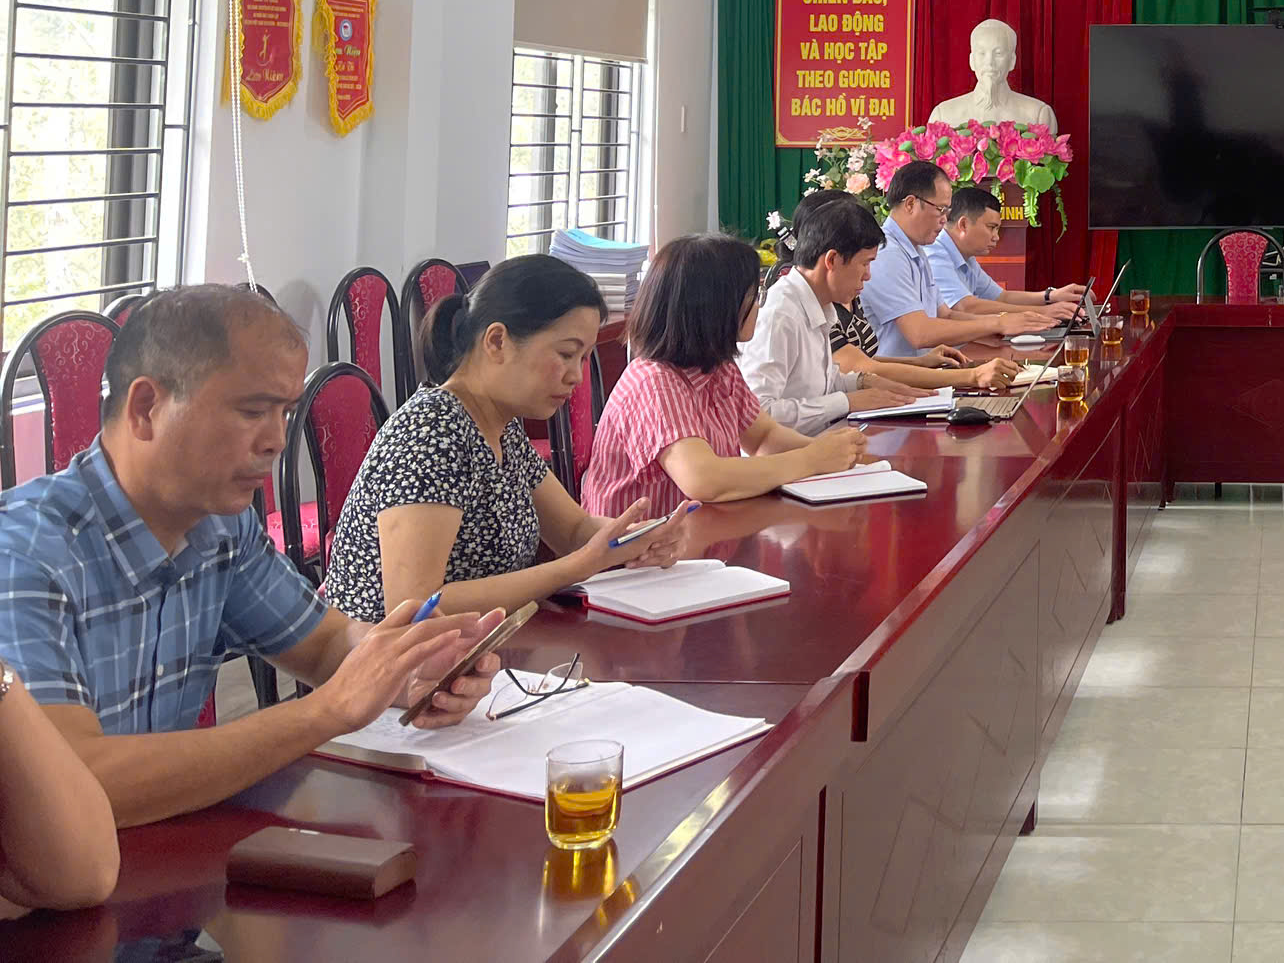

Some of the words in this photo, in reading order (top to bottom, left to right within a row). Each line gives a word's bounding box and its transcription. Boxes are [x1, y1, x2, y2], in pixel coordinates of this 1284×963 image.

[809, 14, 838, 32] LAO
[842, 11, 884, 35] ĐỘNG
[800, 39, 820, 60] VÀ
[824, 42, 854, 63] HỌC
[859, 39, 888, 63] TẬP
[797, 70, 834, 87] THEO
[839, 69, 890, 88] GƯƠNG
[791, 95, 821, 116] BÁC
[826, 93, 846, 116] HỒ
[851, 96, 865, 116] VĨ
[869, 98, 894, 120] ĐẠI
